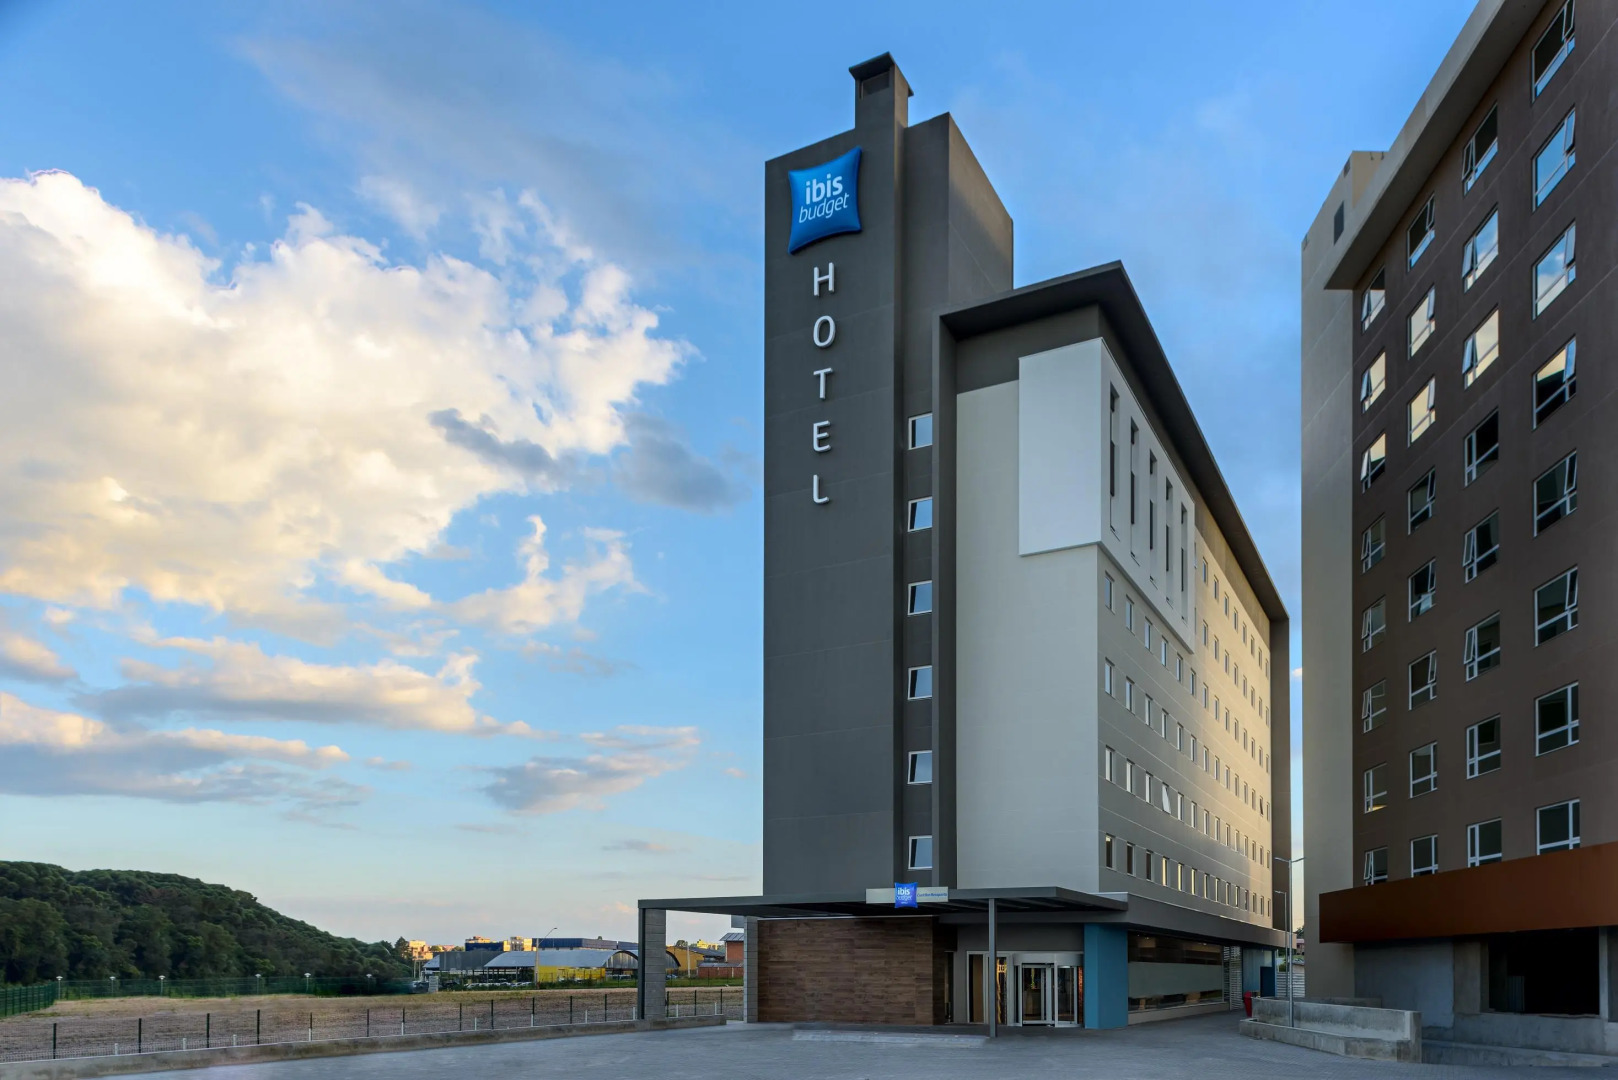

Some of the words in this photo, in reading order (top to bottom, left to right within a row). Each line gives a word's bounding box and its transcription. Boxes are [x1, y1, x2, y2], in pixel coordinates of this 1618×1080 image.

[805, 173, 843, 205] ibis
[799, 192, 849, 223] budget
[813, 262, 836, 504] HOTEL
[897, 887, 911, 895] ibis
